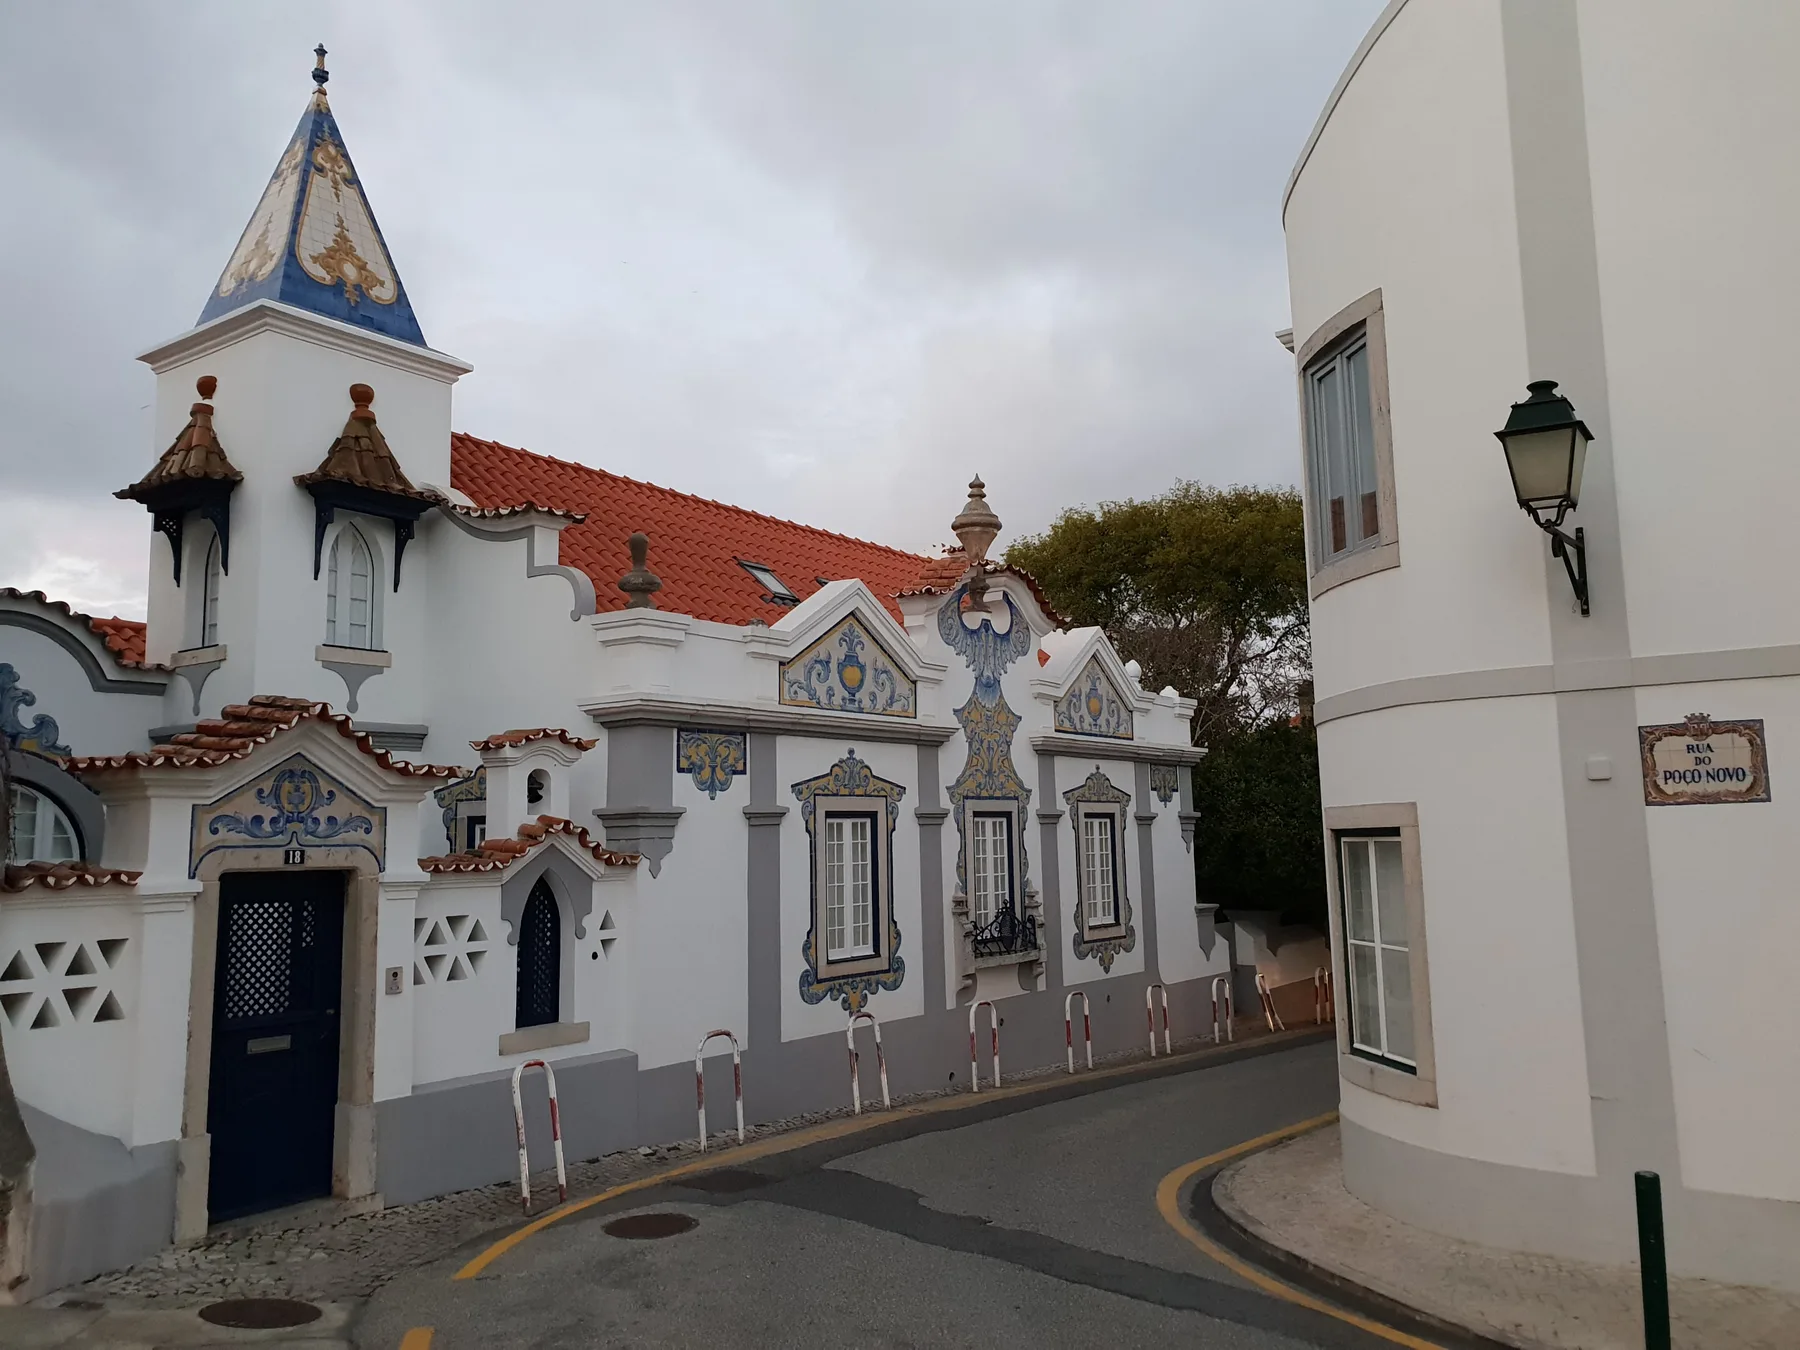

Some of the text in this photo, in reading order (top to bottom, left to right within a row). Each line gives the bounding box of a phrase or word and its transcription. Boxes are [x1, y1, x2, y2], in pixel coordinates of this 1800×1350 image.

[1686, 743, 1714, 754] RUA
[1694, 756, 1711, 766] DO
[1663, 767, 1746, 786] POÇO NOVO
[289, 850, 301, 864] 18
